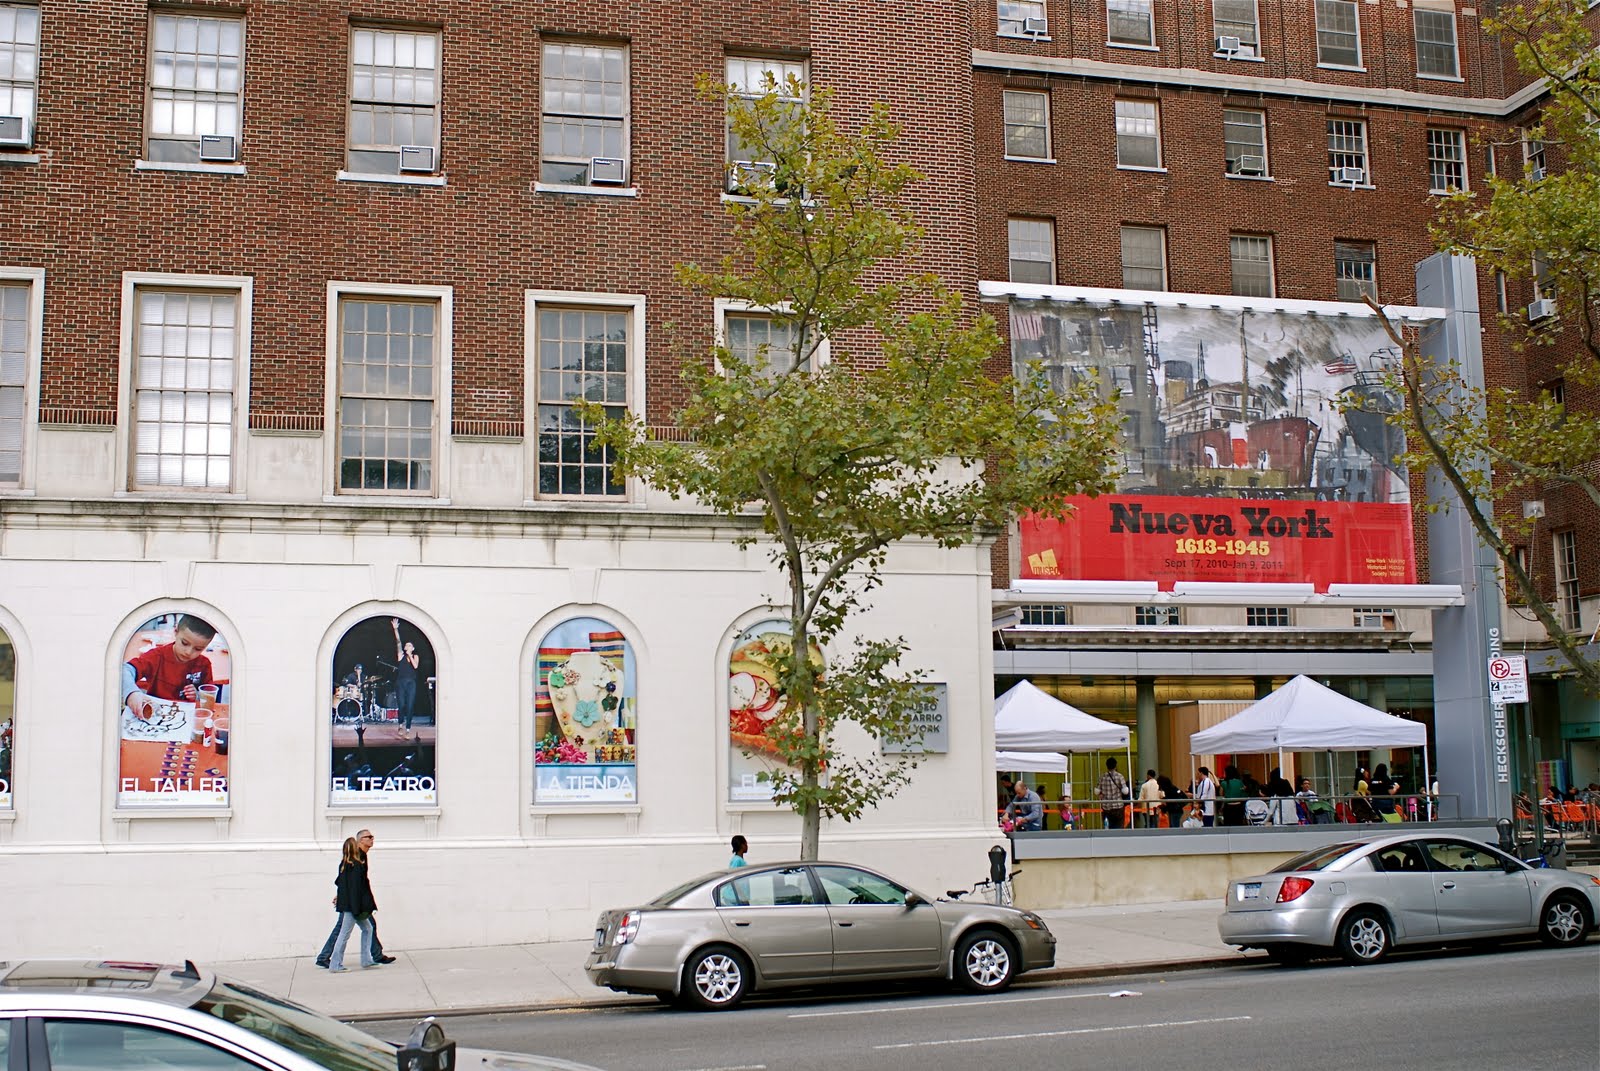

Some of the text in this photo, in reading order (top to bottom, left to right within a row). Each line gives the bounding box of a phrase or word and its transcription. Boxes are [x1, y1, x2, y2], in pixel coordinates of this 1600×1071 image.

[1109, 503, 1237, 537] Nueva
[1240, 507, 1334, 539] York
[1165, 558, 1186, 569] Sept
[1191, 559, 1203, 569] 17,
[1250, 560, 1258, 570] 9,
[1261, 560, 1283, 570] 2011
[907, 713, 943, 723] ARRIO
[1494, 702, 1509, 783] HECKSCHER
[121, 777, 228, 793] EL TALLER
[332, 776, 435, 792] EL TEATRO
[537, 775, 634, 790] LA TIENDA
